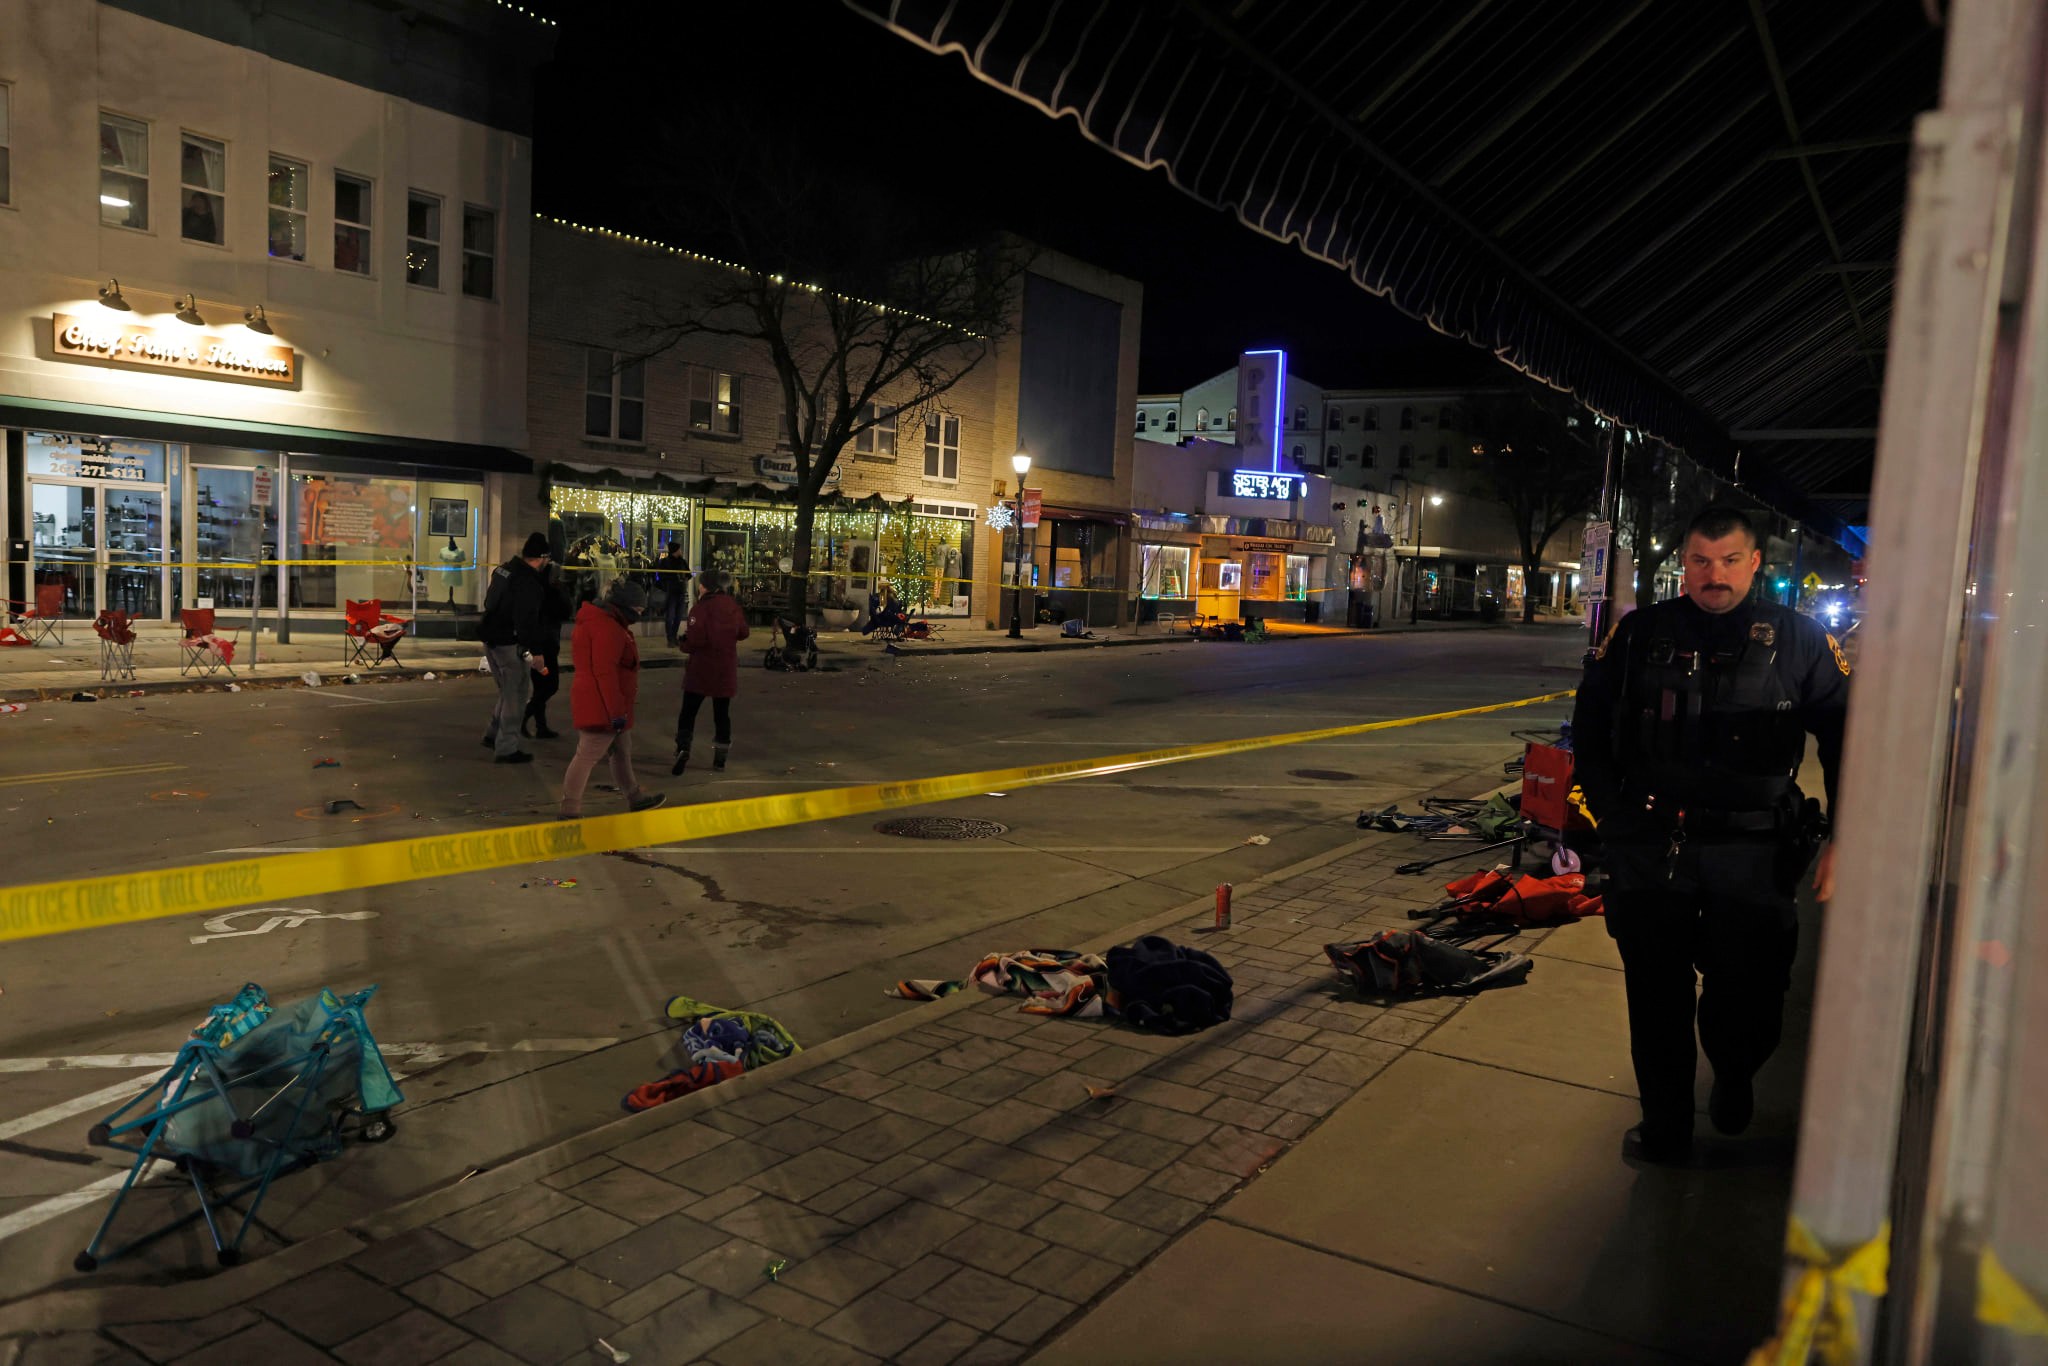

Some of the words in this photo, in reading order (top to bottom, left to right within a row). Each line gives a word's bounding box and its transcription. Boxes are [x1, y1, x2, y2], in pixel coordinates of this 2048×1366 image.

[61, 324, 122, 357] Chef
[49, 462, 144, 480] 262-271-6121
[1233, 474, 1269, 488] SISTER
[1271, 477, 1292, 489] ACT
[1235, 484, 1258, 497] Dec.
[1260, 486, 1268, 498] 3
[1276, 487, 1289, 499] 19
